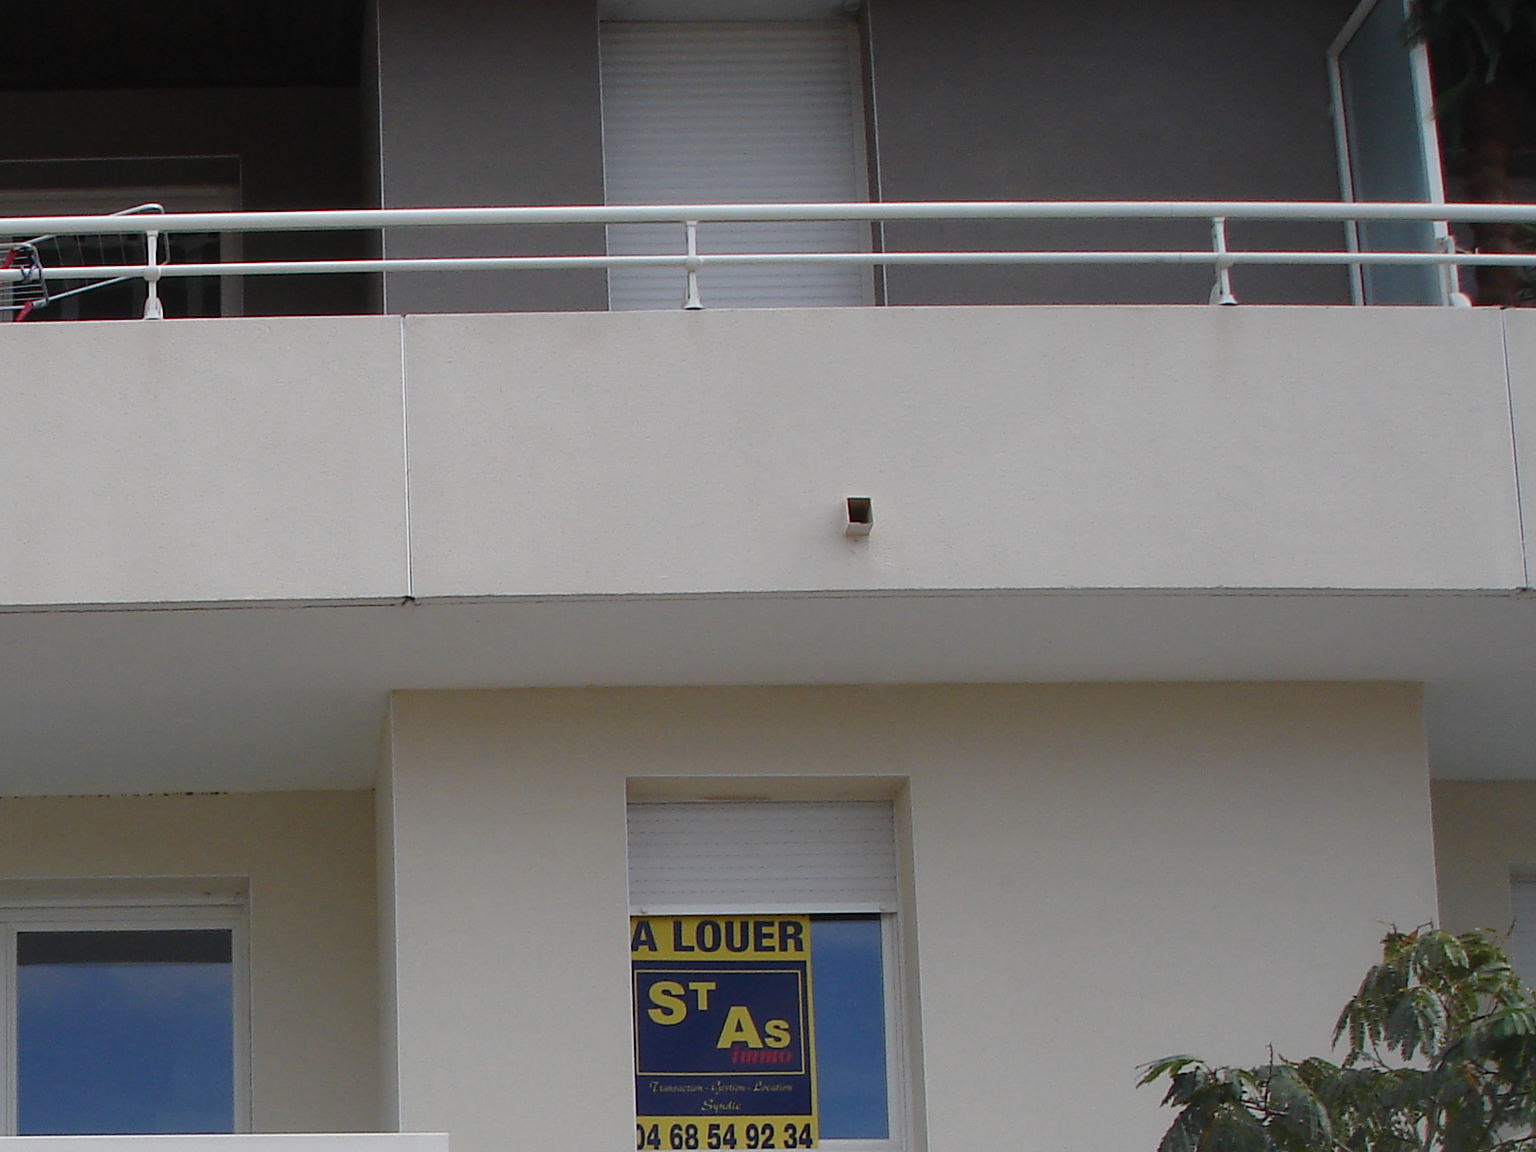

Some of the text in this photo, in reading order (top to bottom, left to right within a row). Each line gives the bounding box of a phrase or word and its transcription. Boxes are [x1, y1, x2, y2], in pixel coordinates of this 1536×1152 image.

[631, 920, 804, 952] A LOUER
[649, 1080, 793, 1095] Transaction Gestion Location
[701, 1099, 742, 1114] Syndic
[670, 1123, 699, 1150] 68
[707, 1123, 737, 1149] 54
[745, 1123, 775, 1149] 92
[783, 1123, 813, 1149] 34
